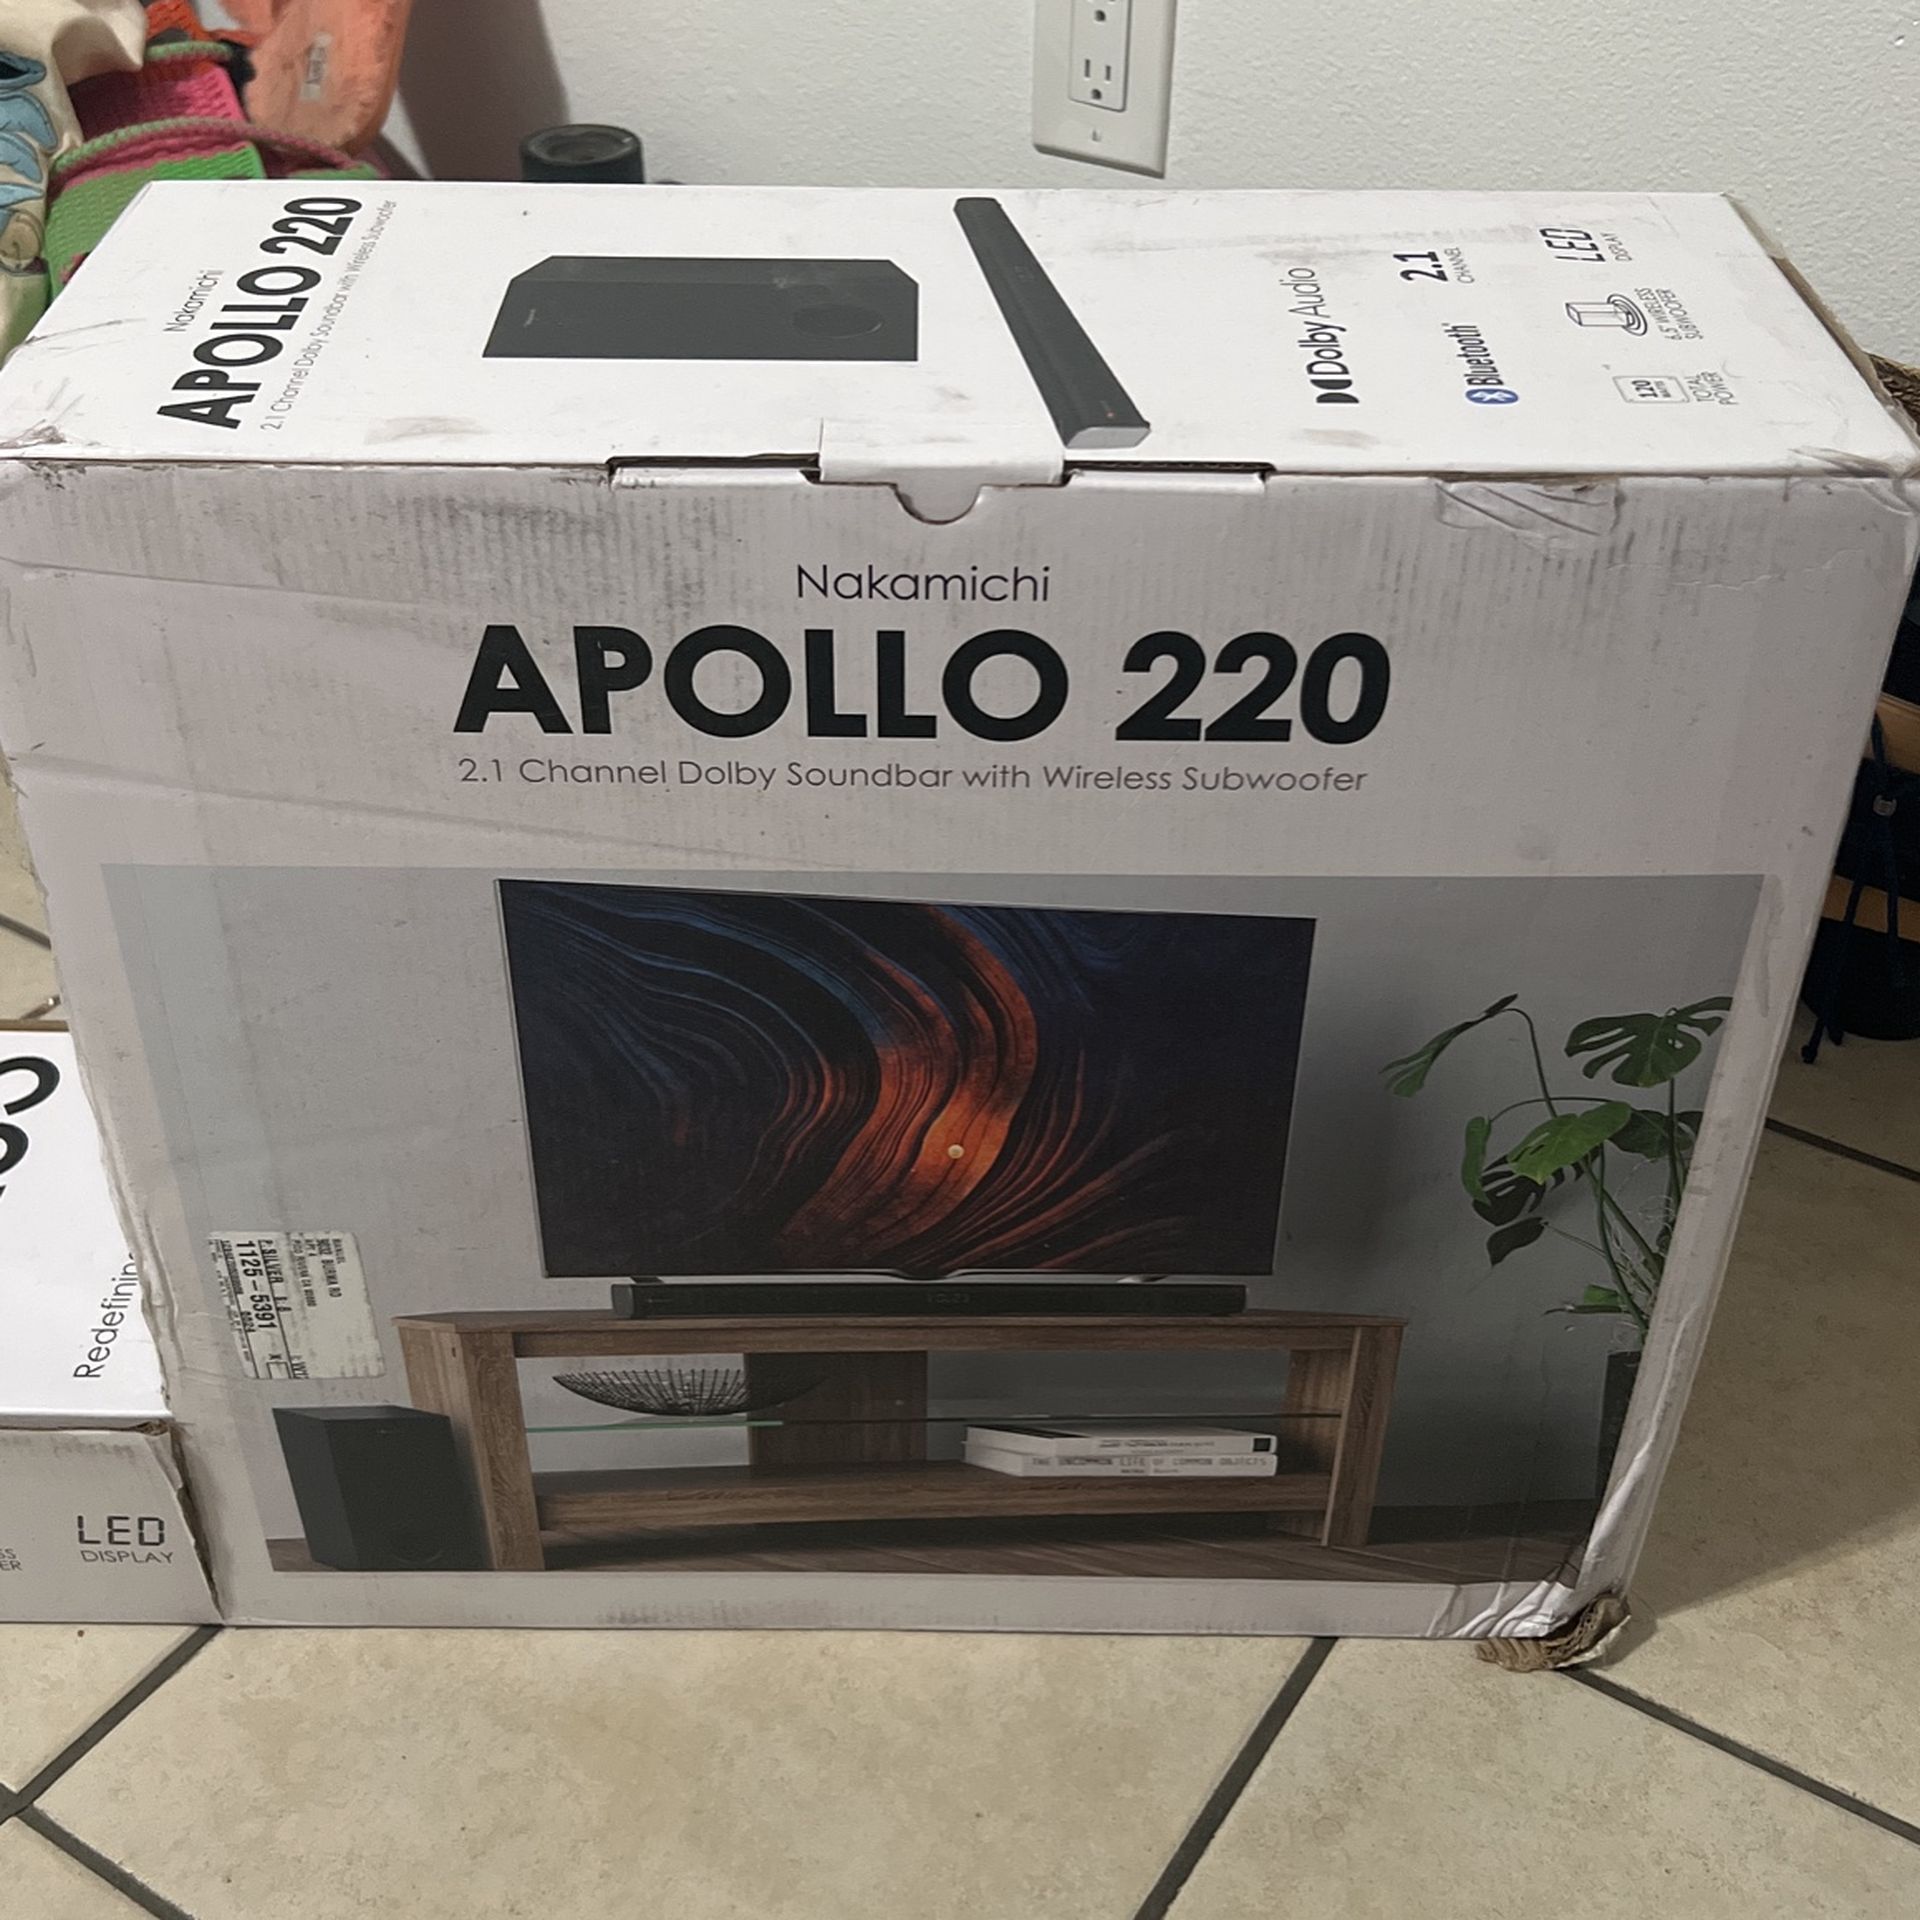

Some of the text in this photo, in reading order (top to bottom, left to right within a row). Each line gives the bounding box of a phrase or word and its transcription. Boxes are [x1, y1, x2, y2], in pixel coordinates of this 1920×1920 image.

[1392, 251, 1449, 282] 2.1
[1539, 228, 1606, 262] LED
[156, 196, 363, 430] APOLLO 220
[163, 269, 225, 332] Nakamichi
[1279, 267, 1350, 376] Dolby Audio
[1443, 324, 1504, 386] Bluetooth
[796, 564, 1051, 602] Nakamichi
[453, 623, 1391, 745] APOLLO 220
[458, 758, 1369, 791] 2.1 Channel Dolby Soundbar with Wireless Subwoofer
[73, 1252, 138, 1378] Redefinin
[77, 1515, 165, 1546] LED
[81, 1550, 174, 1564] DISPLAY
